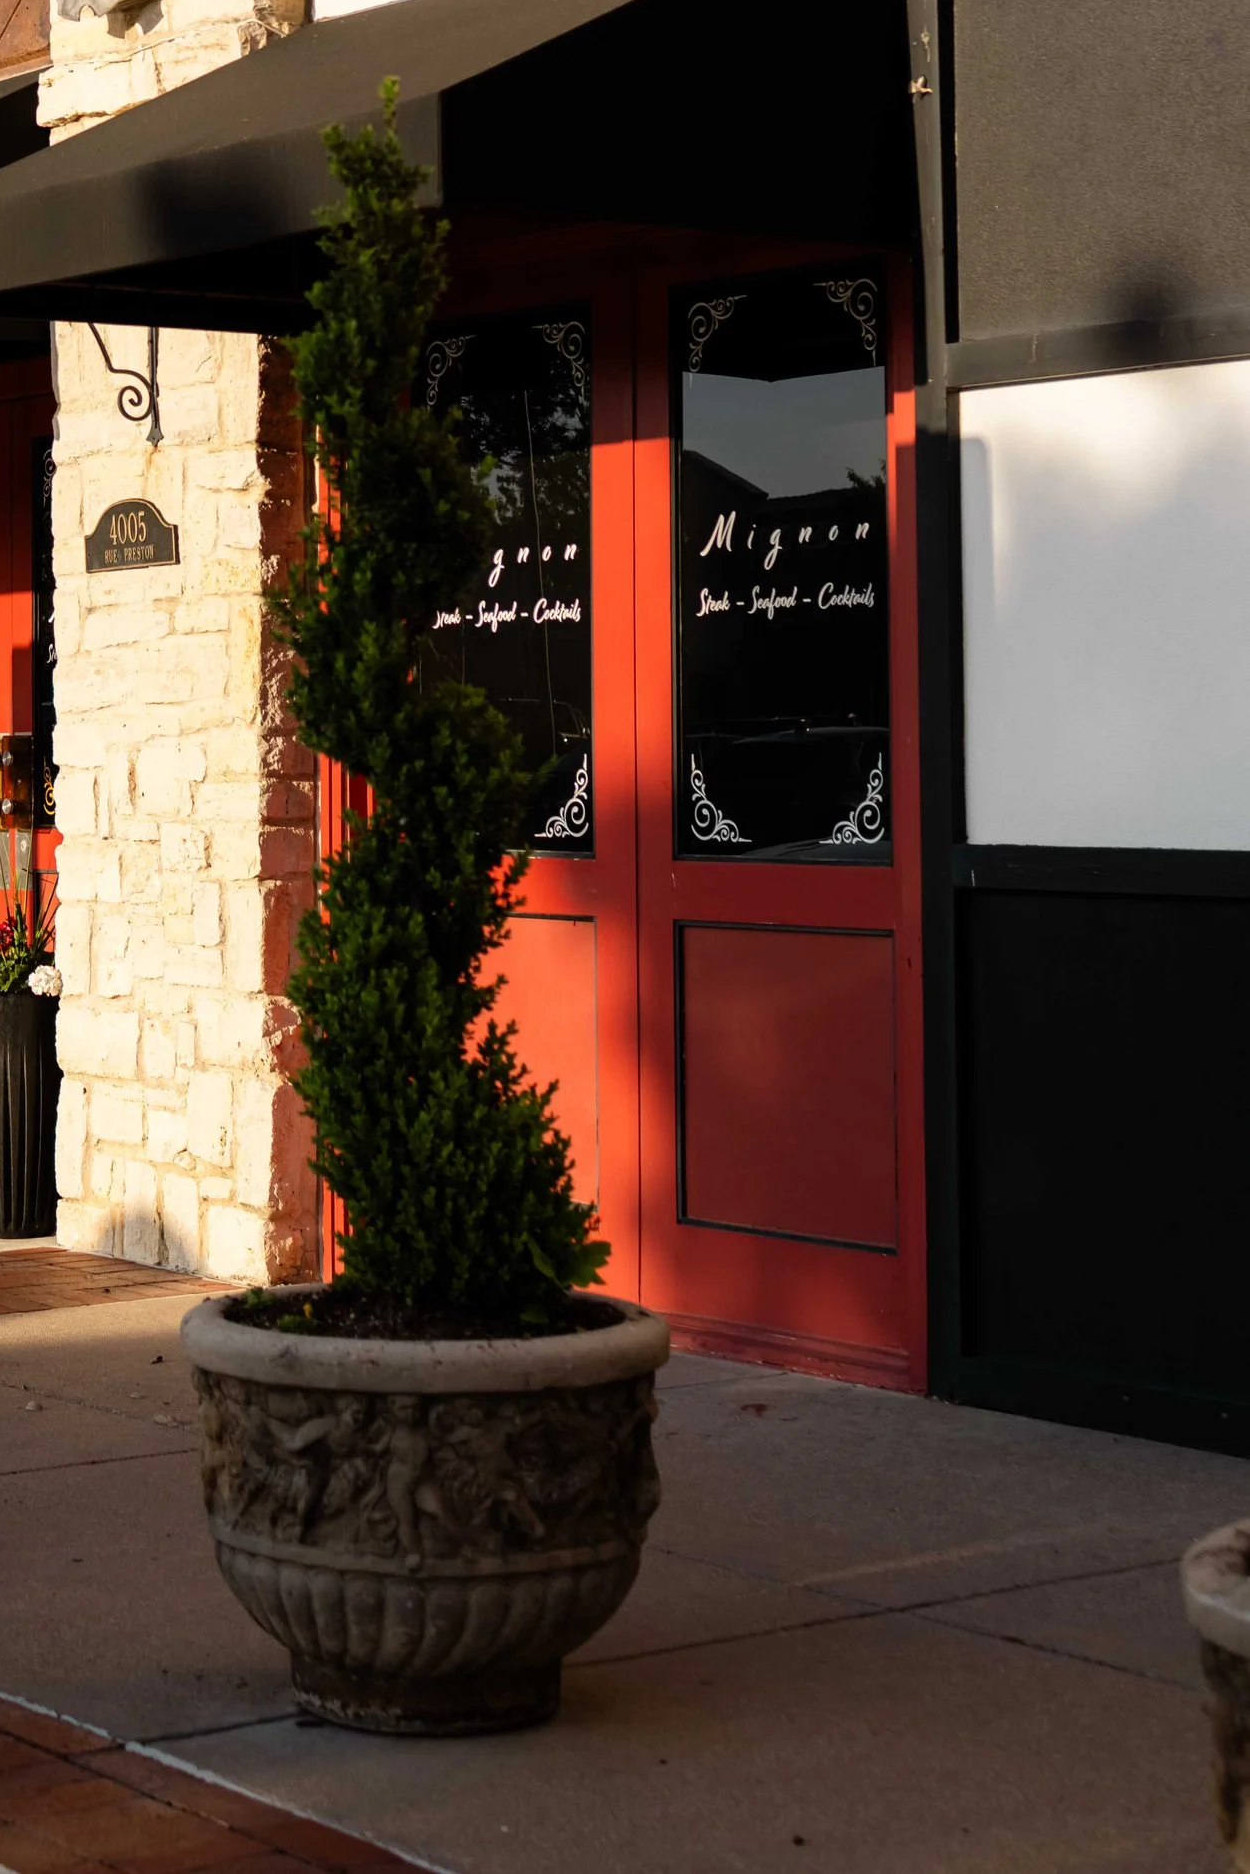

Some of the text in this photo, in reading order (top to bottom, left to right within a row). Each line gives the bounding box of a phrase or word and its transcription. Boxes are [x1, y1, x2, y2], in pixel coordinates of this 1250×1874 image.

[110, 511, 147, 546] 4005
[699, 510, 870, 571] Mignon
[104, 544, 155, 564] RUE PRESTON
[487, 543, 578, 588] gnon
[475, 600, 517, 633] Seafood
[533, 597, 581, 624] Cocktails
[696, 587, 731, 617] Steak
[747, 585, 798, 620] Seafood
[817, 582, 875, 610] Cocktails
